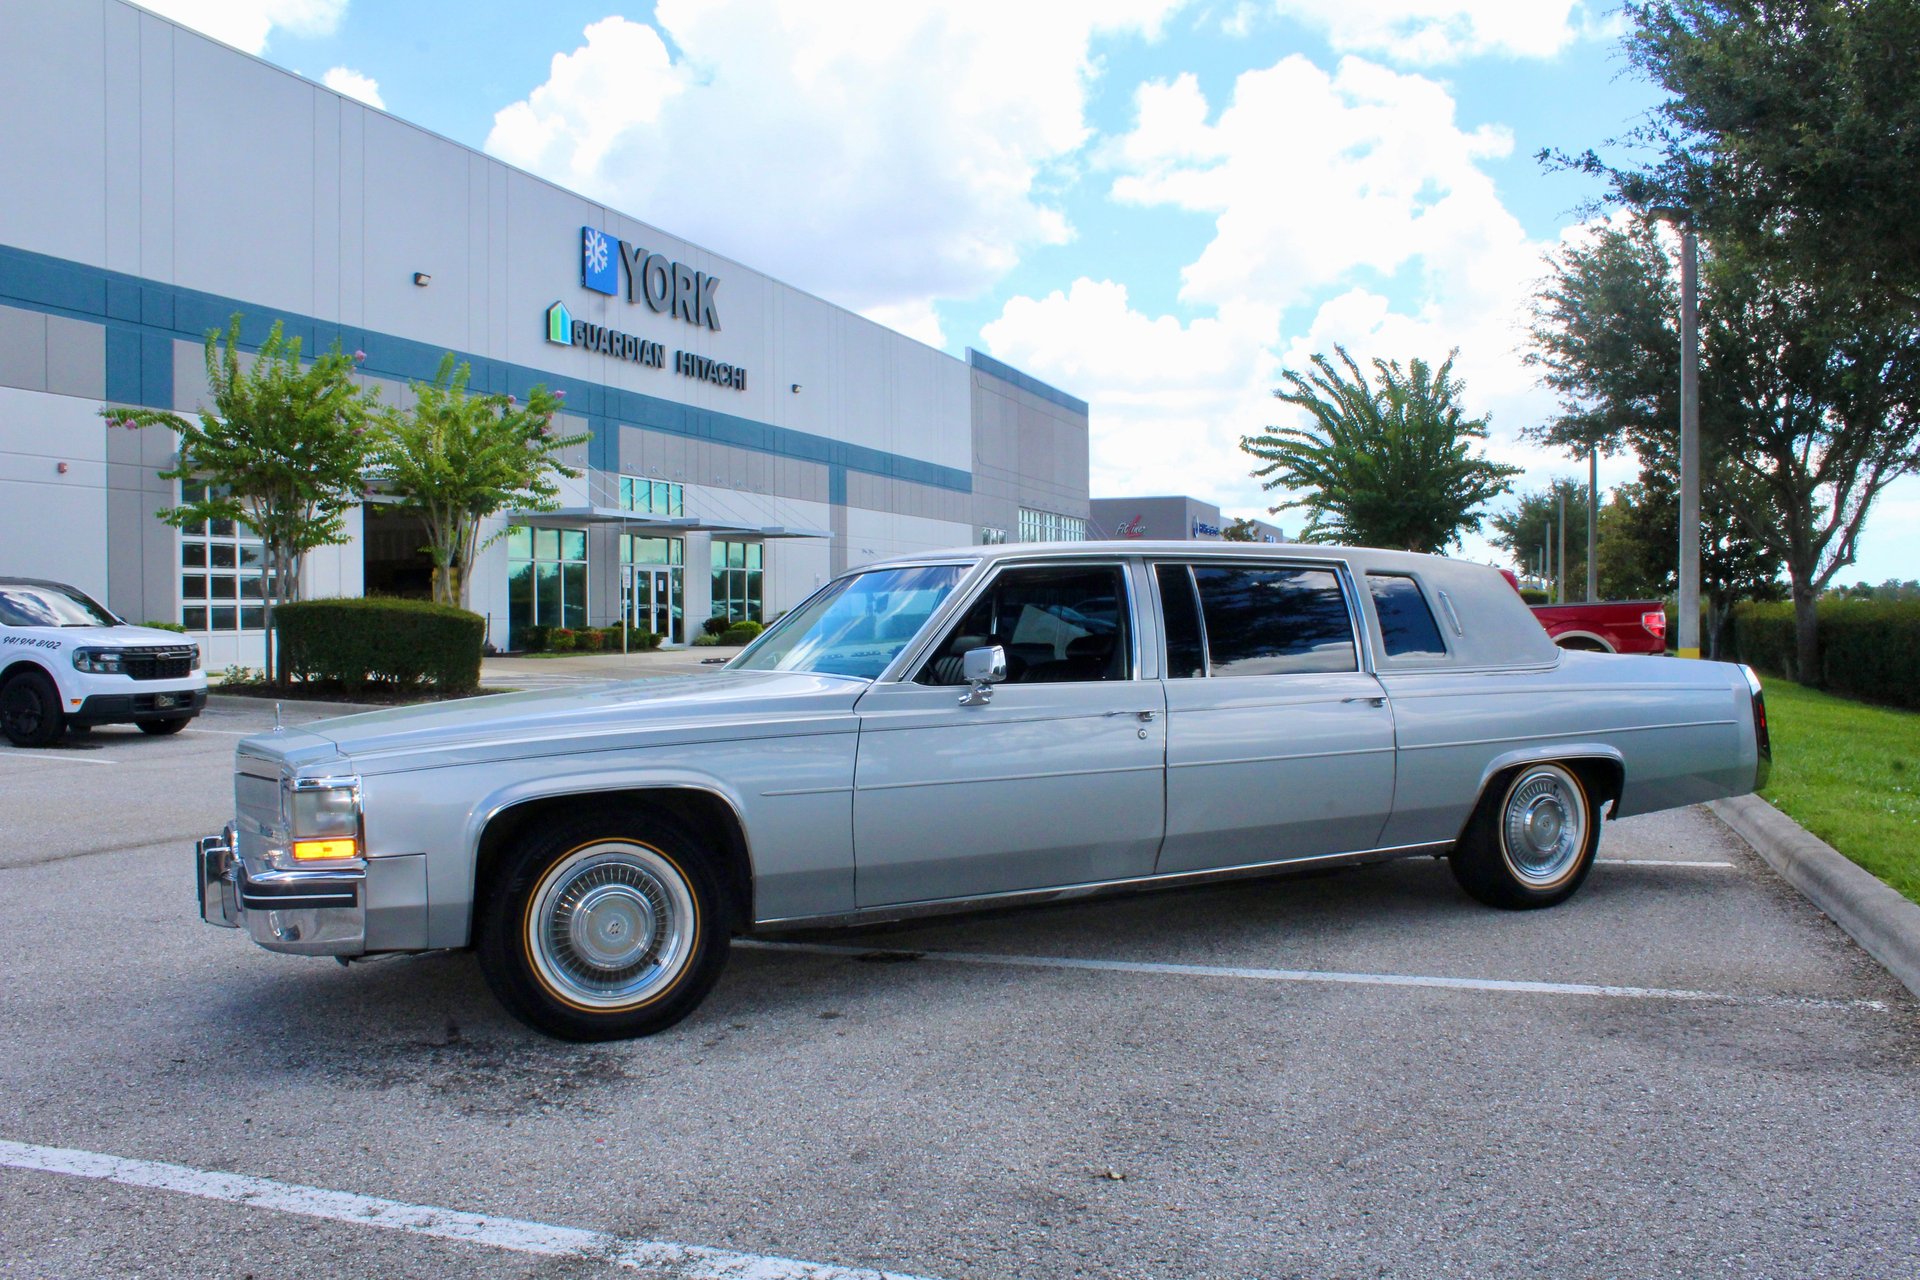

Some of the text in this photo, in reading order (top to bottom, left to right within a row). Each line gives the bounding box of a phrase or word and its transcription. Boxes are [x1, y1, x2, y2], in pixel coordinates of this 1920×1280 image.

[619, 240, 721, 331] YORK
[572, 320, 747, 390] GUARDIAN HITACHI
